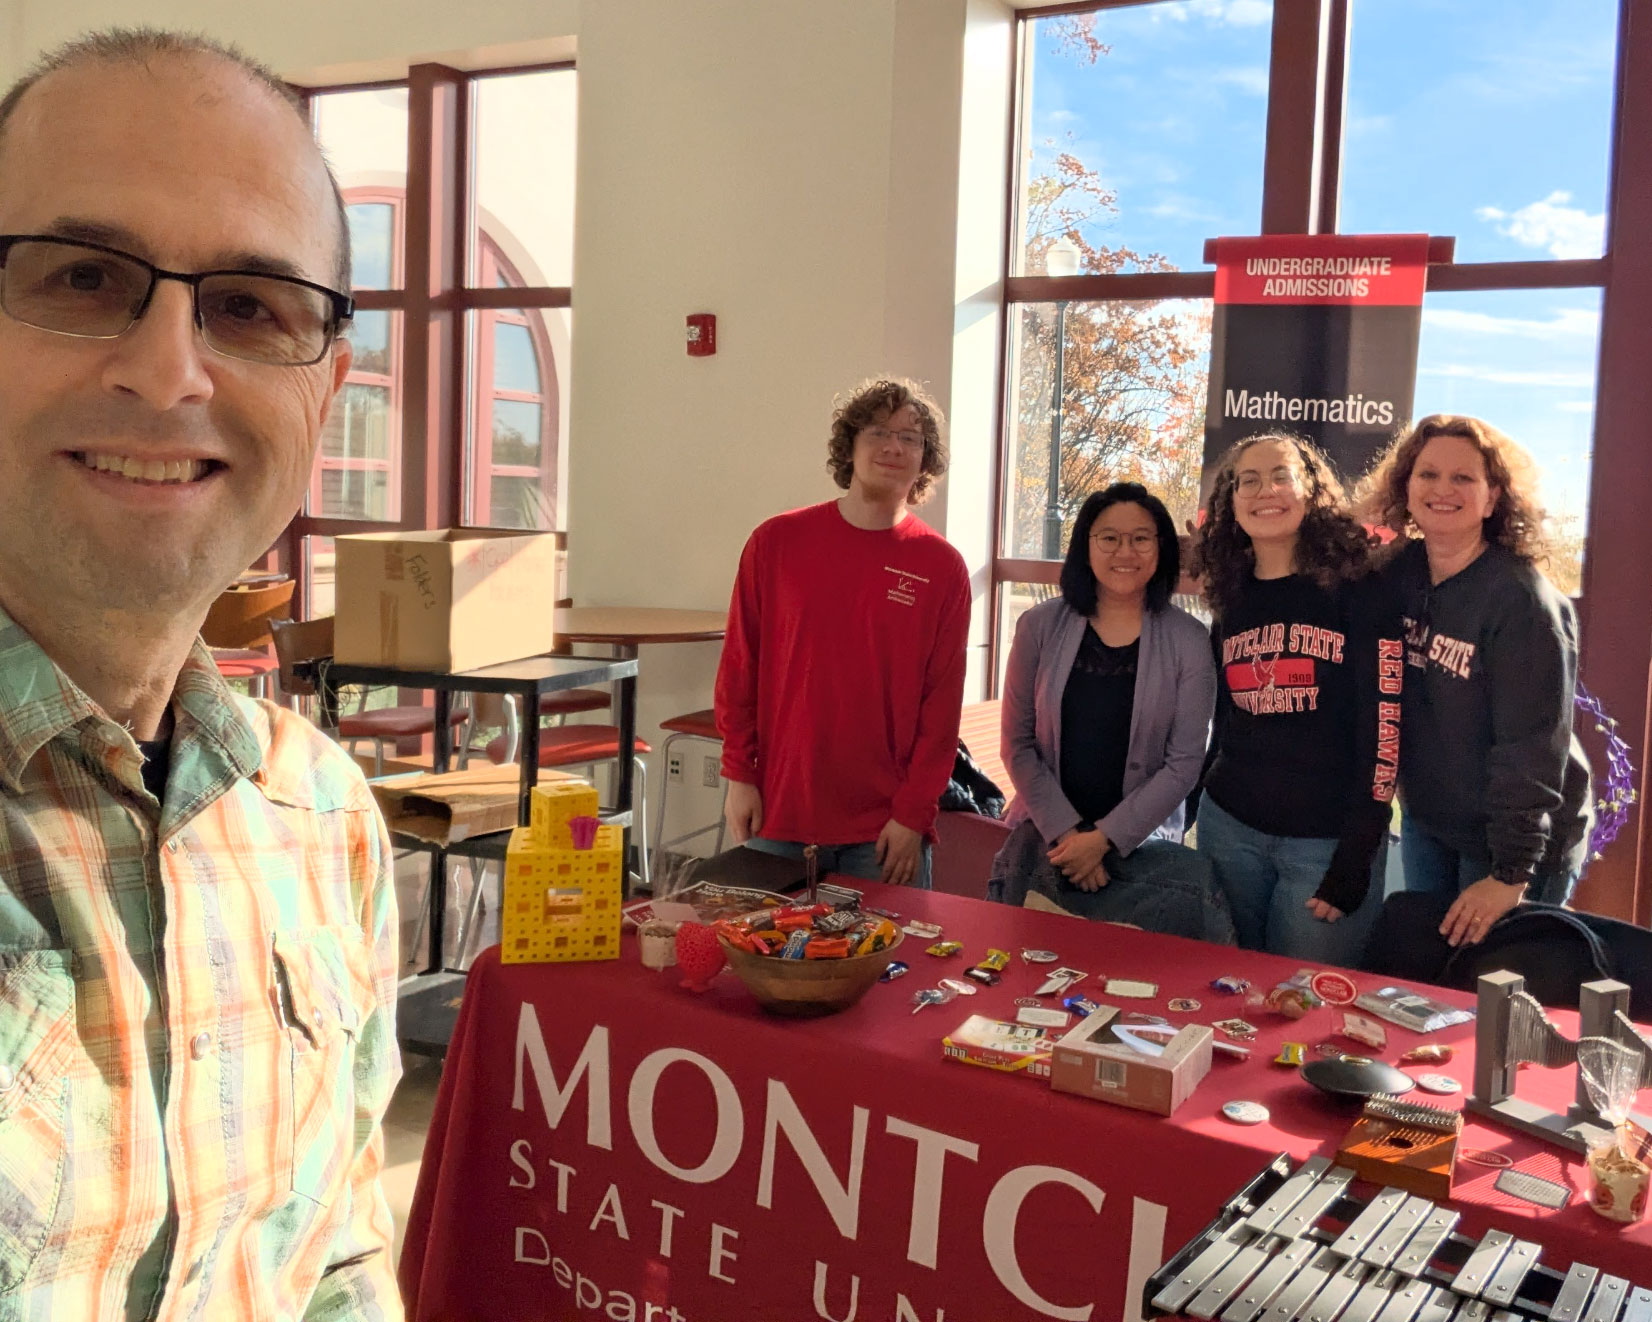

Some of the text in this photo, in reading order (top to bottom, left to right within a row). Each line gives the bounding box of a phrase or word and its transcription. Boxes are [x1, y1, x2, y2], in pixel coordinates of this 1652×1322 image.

[1246, 257, 1392, 276] UNDERGRADUATE
[1262, 278, 1369, 297] ADMISSIONS
[1224, 389, 1393, 425] Mathematics
[1288, 623, 1345, 663] STATE
[1428, 633, 1476, 680] STATE
[1378, 639, 1403, 694] RED
[1372, 701, 1401, 801] HAWKS
[508, 1139, 740, 1285] STATE
